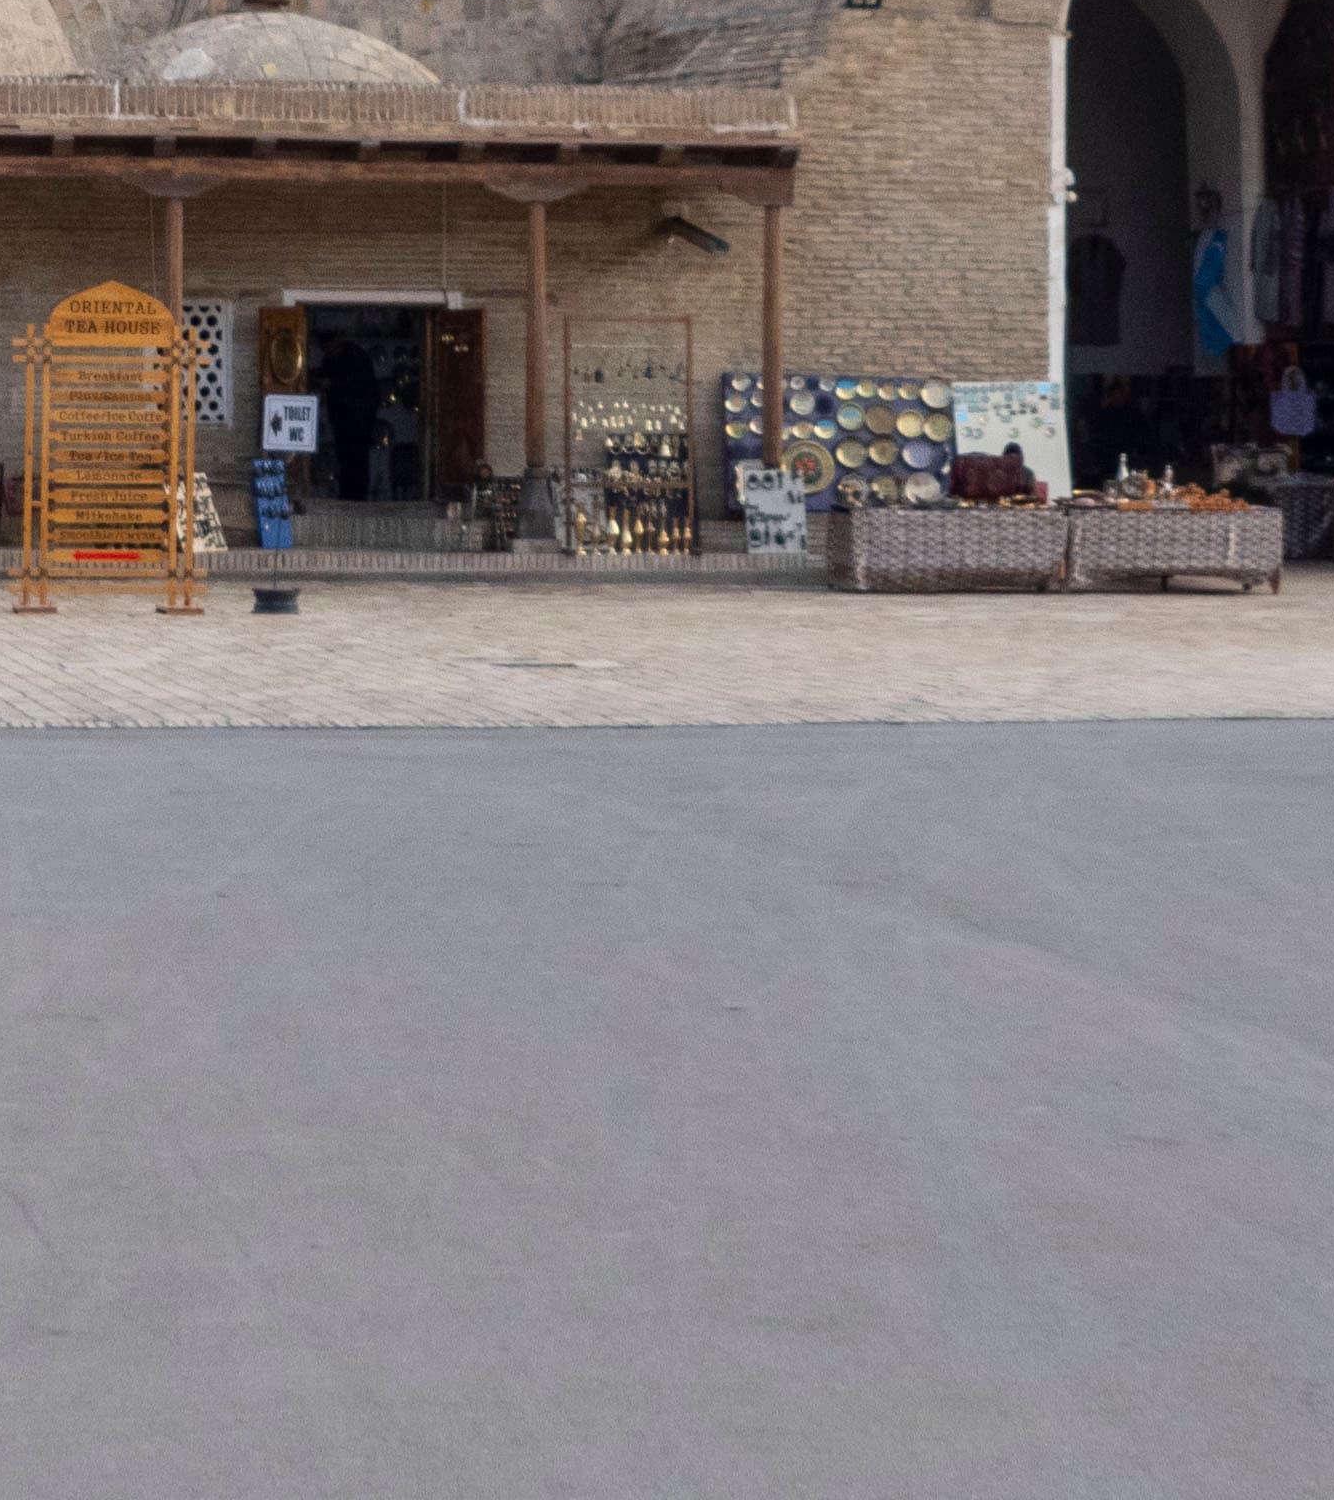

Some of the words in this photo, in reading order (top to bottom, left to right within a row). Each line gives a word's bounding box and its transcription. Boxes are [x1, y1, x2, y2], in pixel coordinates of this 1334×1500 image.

[69, 300, 156, 315] ORIENTAL
[64, 319, 97, 334] TEA
[104, 320, 161, 335] HOUSE
[78, 370, 142, 381] Breakfast
[283, 406, 311, 421] TOILET
[61, 430, 112, 441] Turkish
[116, 431, 160, 442] Coffee
[289, 426, 304, 442] WC
[69, 450, 93, 461] Tea
[129, 451, 153, 462] Tea
[71, 490, 108, 501] Fresh
[112, 490, 148, 501] Juice
[75, 510, 143, 521] Milkshake
